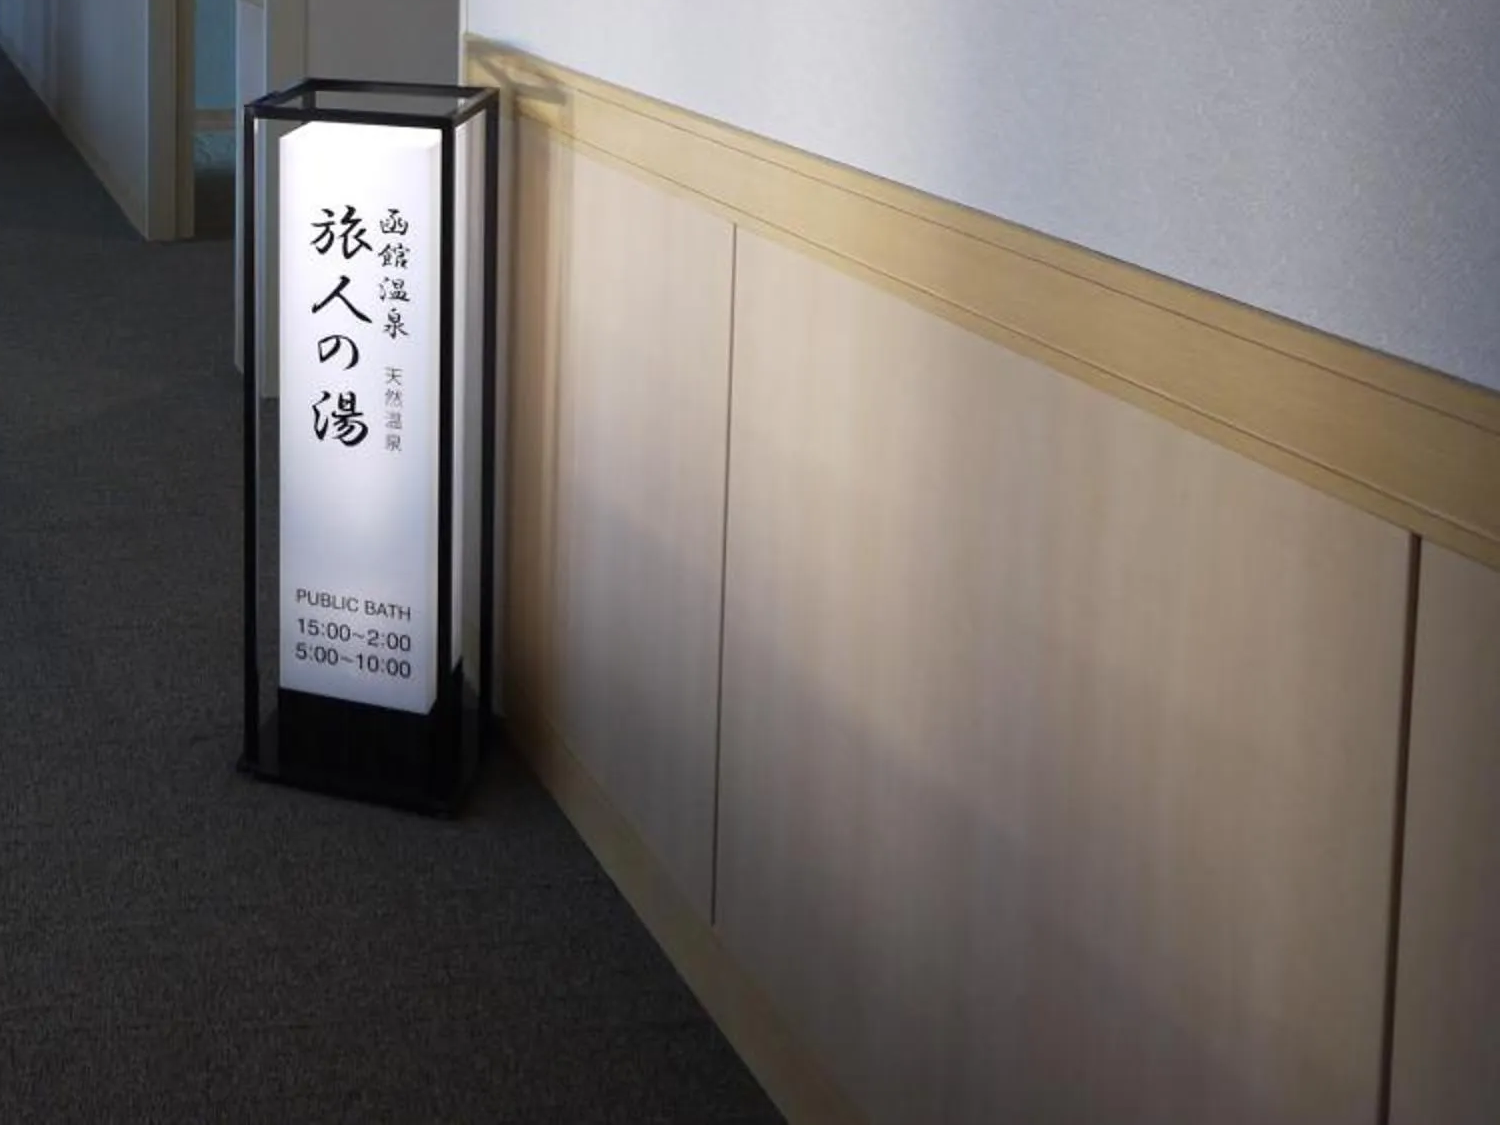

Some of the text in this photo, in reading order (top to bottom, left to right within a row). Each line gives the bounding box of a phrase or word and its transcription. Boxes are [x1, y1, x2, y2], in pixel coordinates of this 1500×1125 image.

[310, 204, 373, 447] 旅人の湯
[378, 207, 410, 339] 函館温泉
[296, 588, 411, 622] PUBLIC BATH
